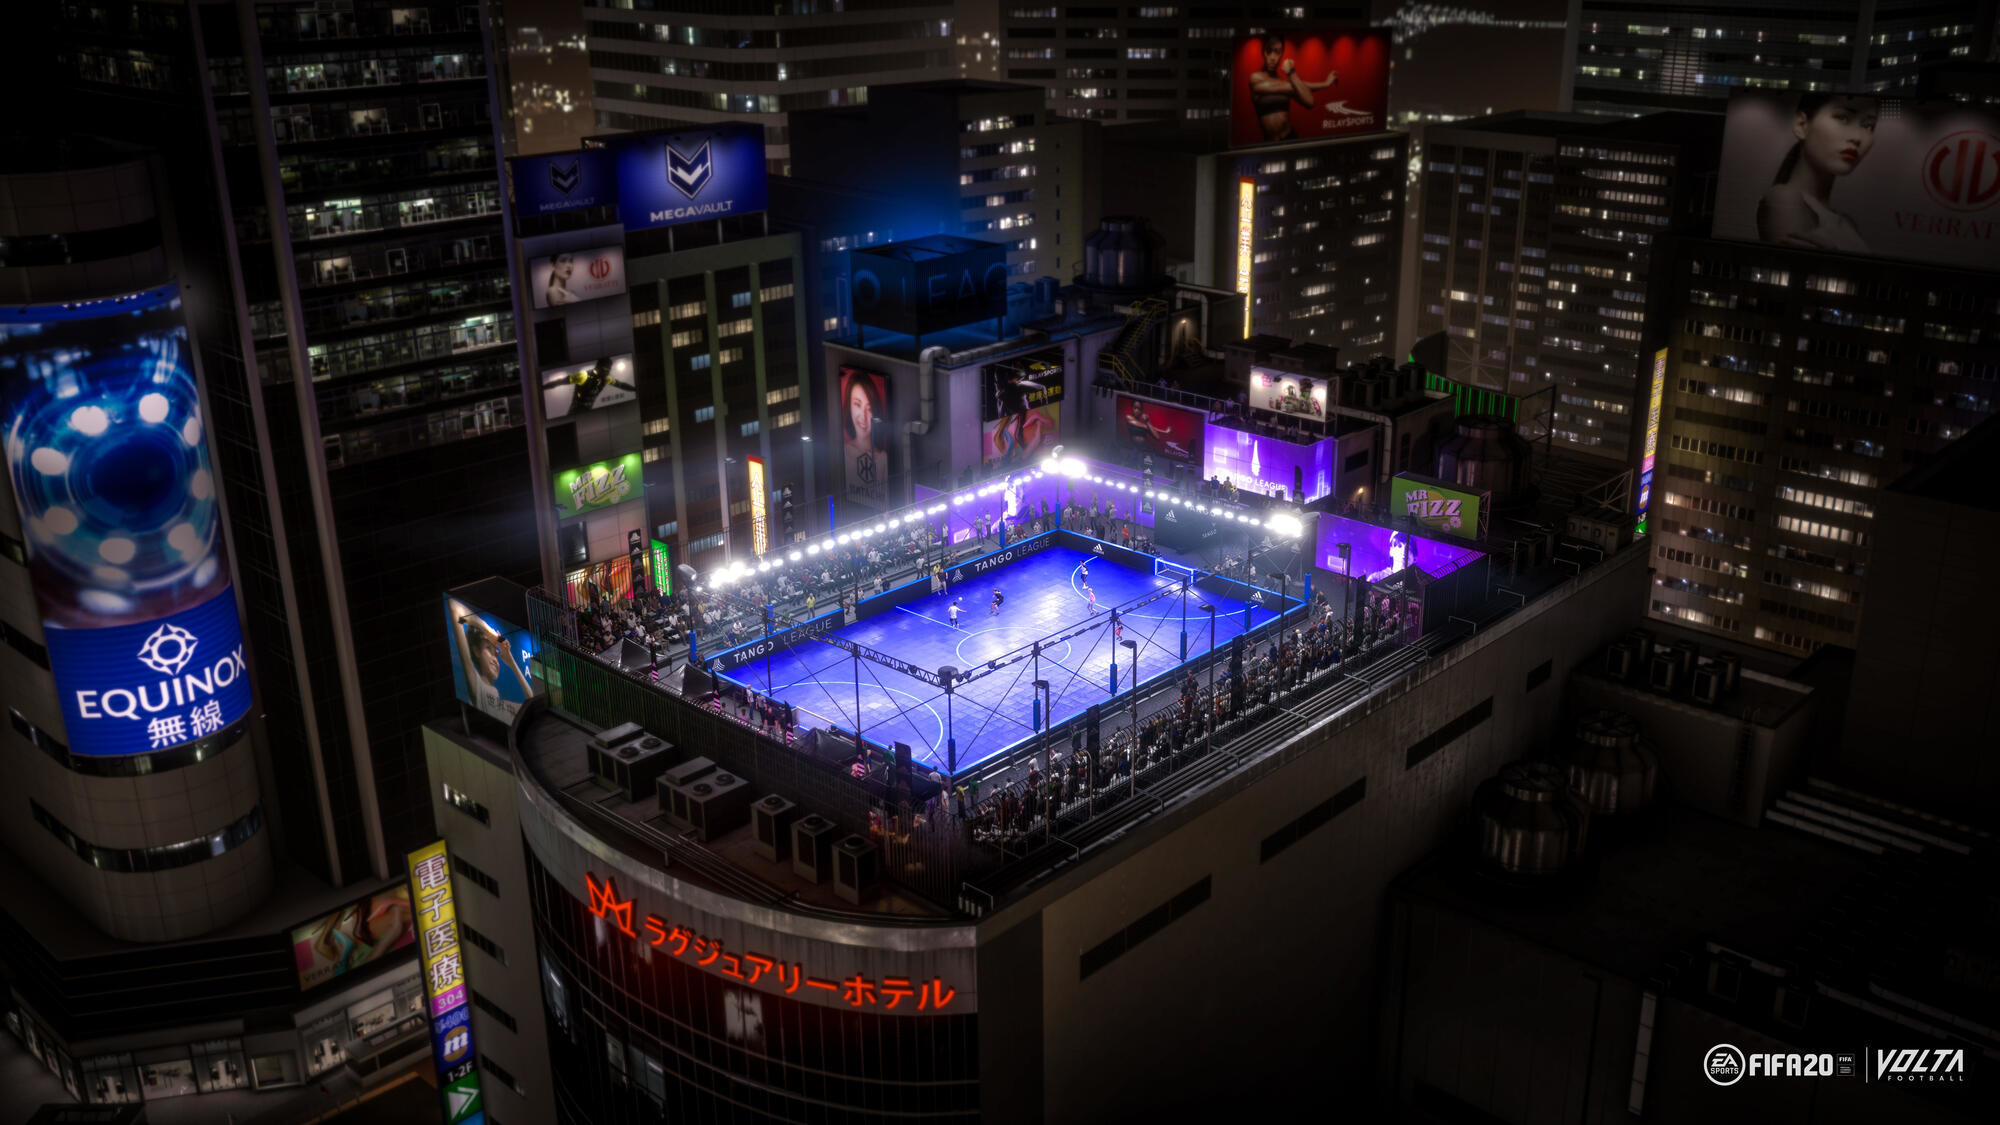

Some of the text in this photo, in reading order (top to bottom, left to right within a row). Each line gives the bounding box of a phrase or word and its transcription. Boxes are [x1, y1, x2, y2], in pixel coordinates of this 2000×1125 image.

[540, 197, 595, 212] MEGAVAULT
[650, 200, 733, 222] MEGAVAULT
[572, 463, 627, 511] FIZZ
[1405, 489, 1428, 502] MR
[1407, 499, 1462, 519] FIZZ
[975, 538, 1050, 572] TANGO LEAGUE
[733, 618, 833, 664] TANGO LEAGUE
[76, 643, 247, 721] EQUINOX
[147, 699, 224, 749] 無線
[415, 853, 462, 991] 電子医療
[645, 914, 955, 1011] ラグジュアリーホテル
[437, 990, 464, 1009] 304
[448, 1061, 473, 1082] 1-2F
